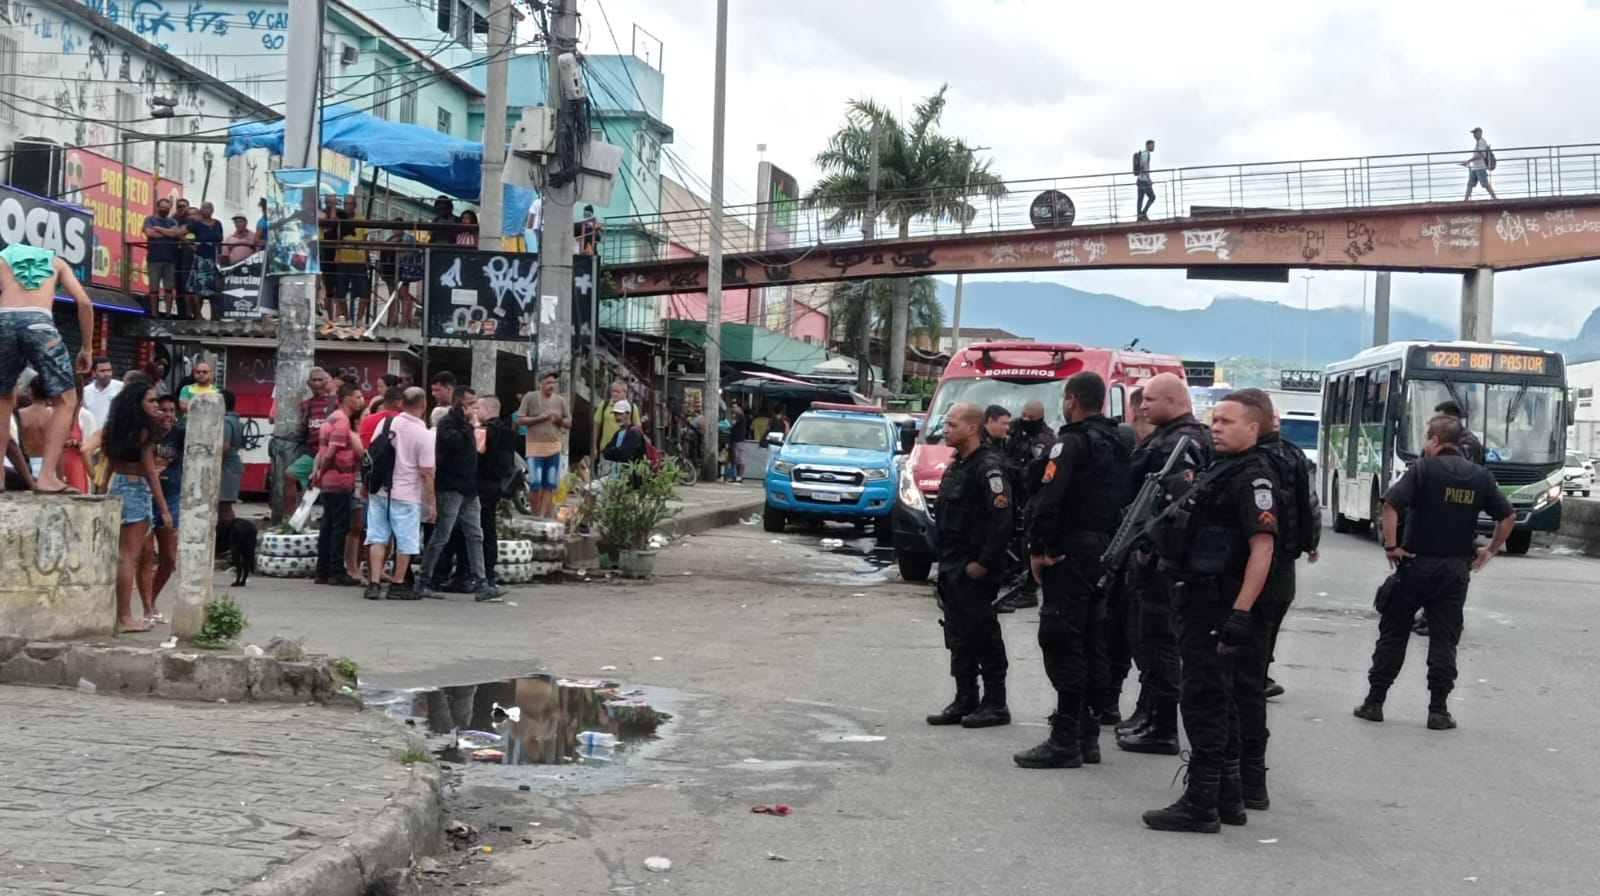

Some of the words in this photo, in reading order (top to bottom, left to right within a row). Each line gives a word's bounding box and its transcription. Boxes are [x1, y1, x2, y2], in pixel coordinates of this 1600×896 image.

[224, 274, 261, 287] Piercin
[1469, 352, 1492, 369] BOM
[1500, 355, 1543, 372] PASTOR
[985, 368, 1055, 377] BOMBEIROS
[1444, 487, 1476, 504] PMERJ
